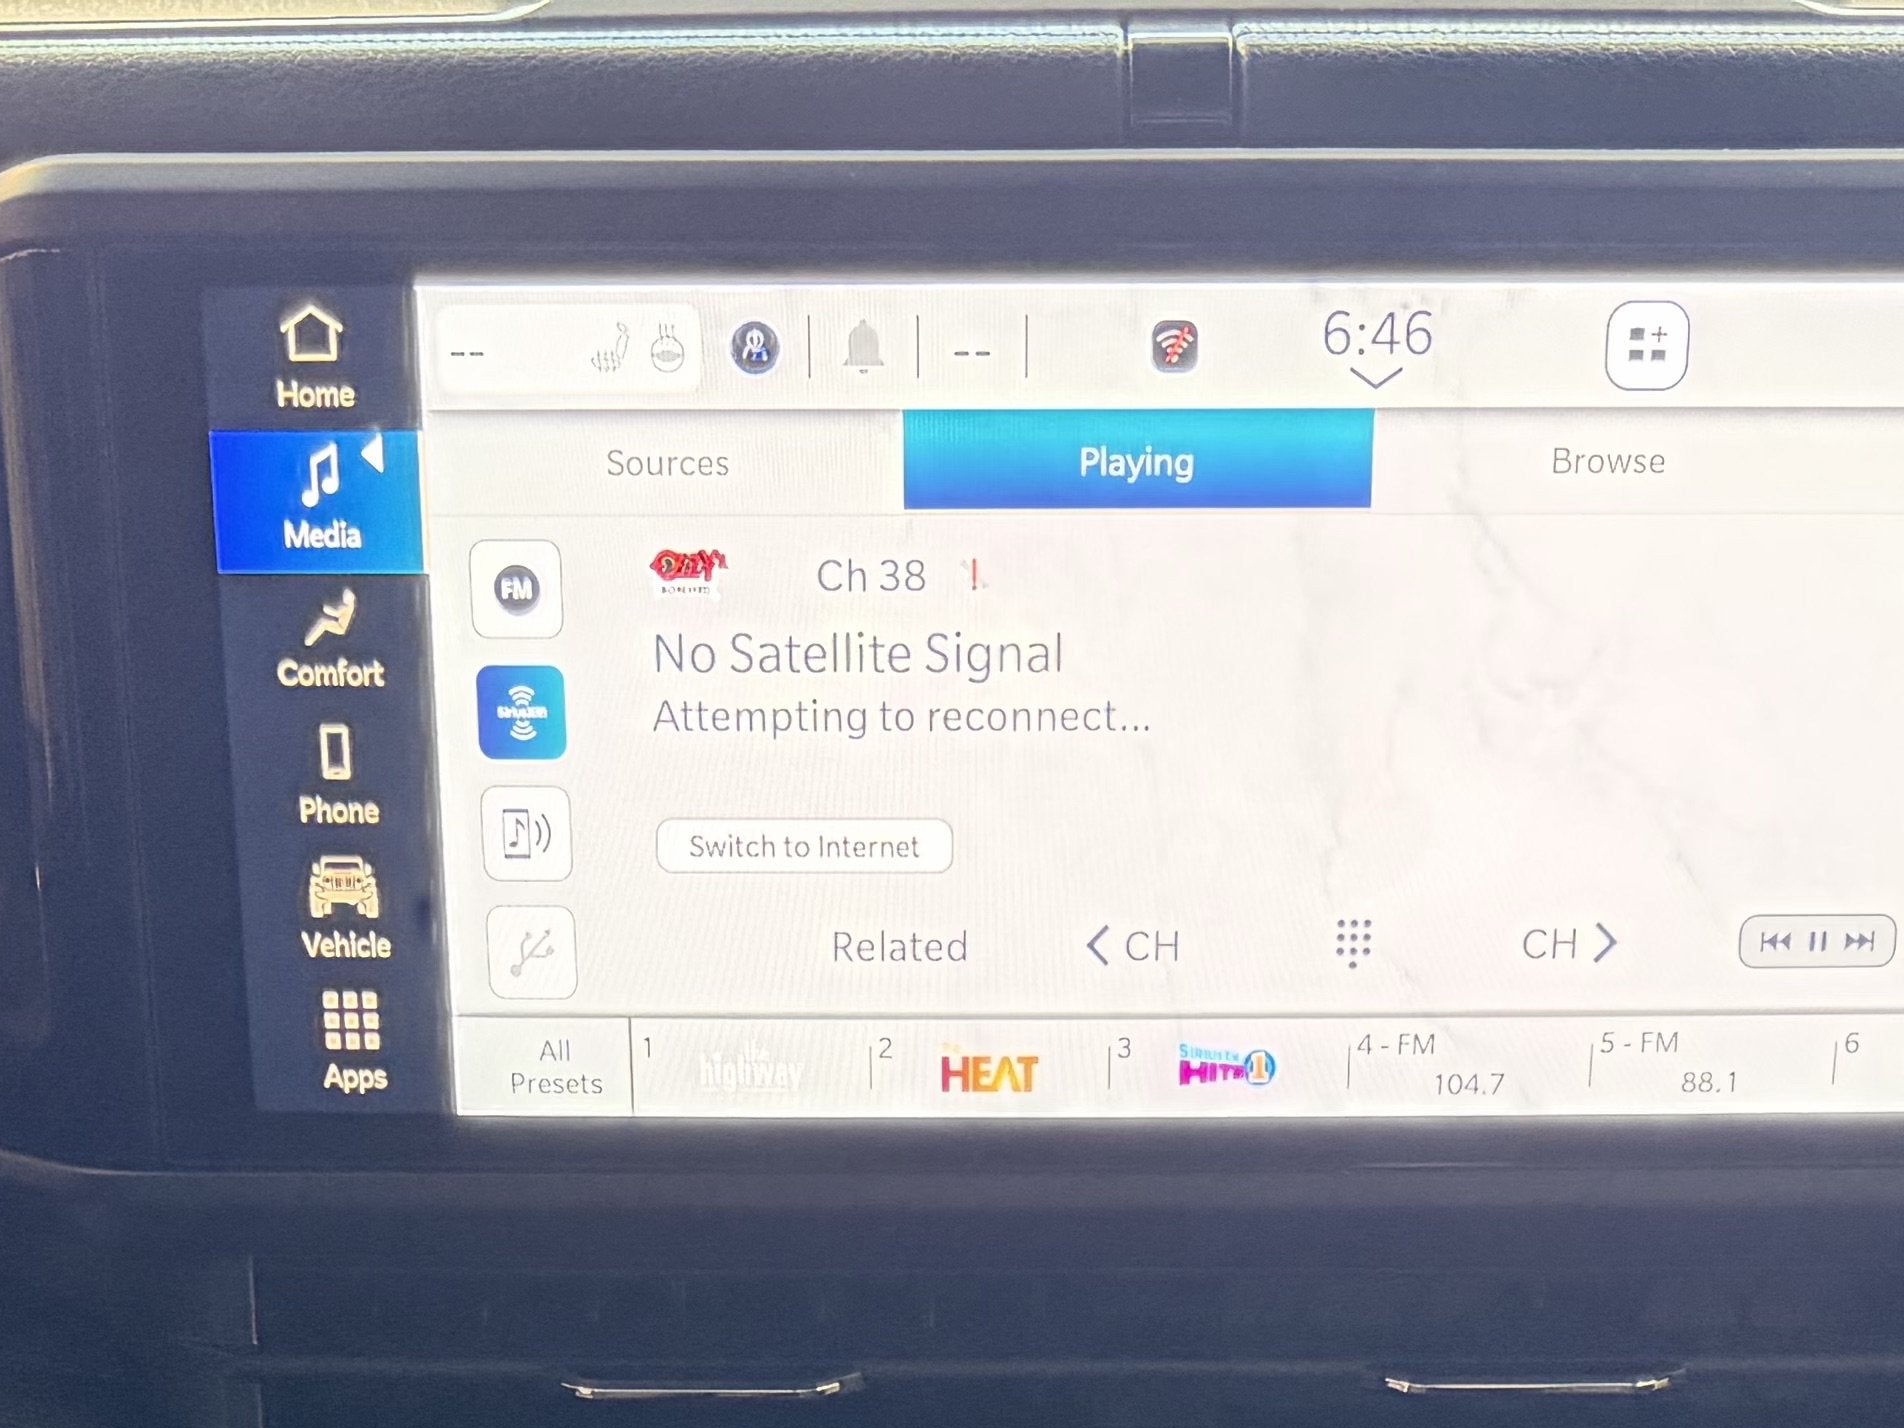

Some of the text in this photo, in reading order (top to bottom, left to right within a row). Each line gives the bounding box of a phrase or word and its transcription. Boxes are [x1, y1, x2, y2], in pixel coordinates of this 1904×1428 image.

[1323, 309, 1434, 358] 6:46
[276, 380, 356, 409] Home
[606, 448, 730, 480] Sources
[1079, 445, 1195, 484] Playing
[1551, 445, 1667, 477] Browse
[283, 519, 362, 550] Media
[500, 577, 533, 600] FM
[817, 558, 926, 592] Ch 38
[277, 657, 385, 689] Comfort
[654, 631, 1063, 685] No Satellite Signal
[653, 698, 1152, 740] Attempting to reconnect...
[299, 796, 380, 826] Phone
[688, 832, 920, 861] Switch to Internet
[301, 930, 392, 960] Vehicle
[833, 928, 968, 964] Related
[1124, 929, 1180, 964] CH
[1522, 926, 1578, 961] CH
[538, 1038, 572, 1063] All
[643, 1036, 652, 1059] 1
[878, 1036, 894, 1060] 2
[1116, 1036, 1133, 1060] 3
[1356, 1033, 1373, 1057] 4
[1397, 1033, 1437, 1057] FM
[1600, 1032, 1615, 1055] 5
[1639, 1031, 1680, 1055] FM
[1845, 1032, 1860, 1055] 6
[323, 1063, 389, 1094] Apps
[510, 1070, 604, 1098] Presets
[941, 1055, 1039, 1093] HEAT
[1434, 1071, 1505, 1098] 104.7
[1680, 1071, 1739, 1095] 88.1
